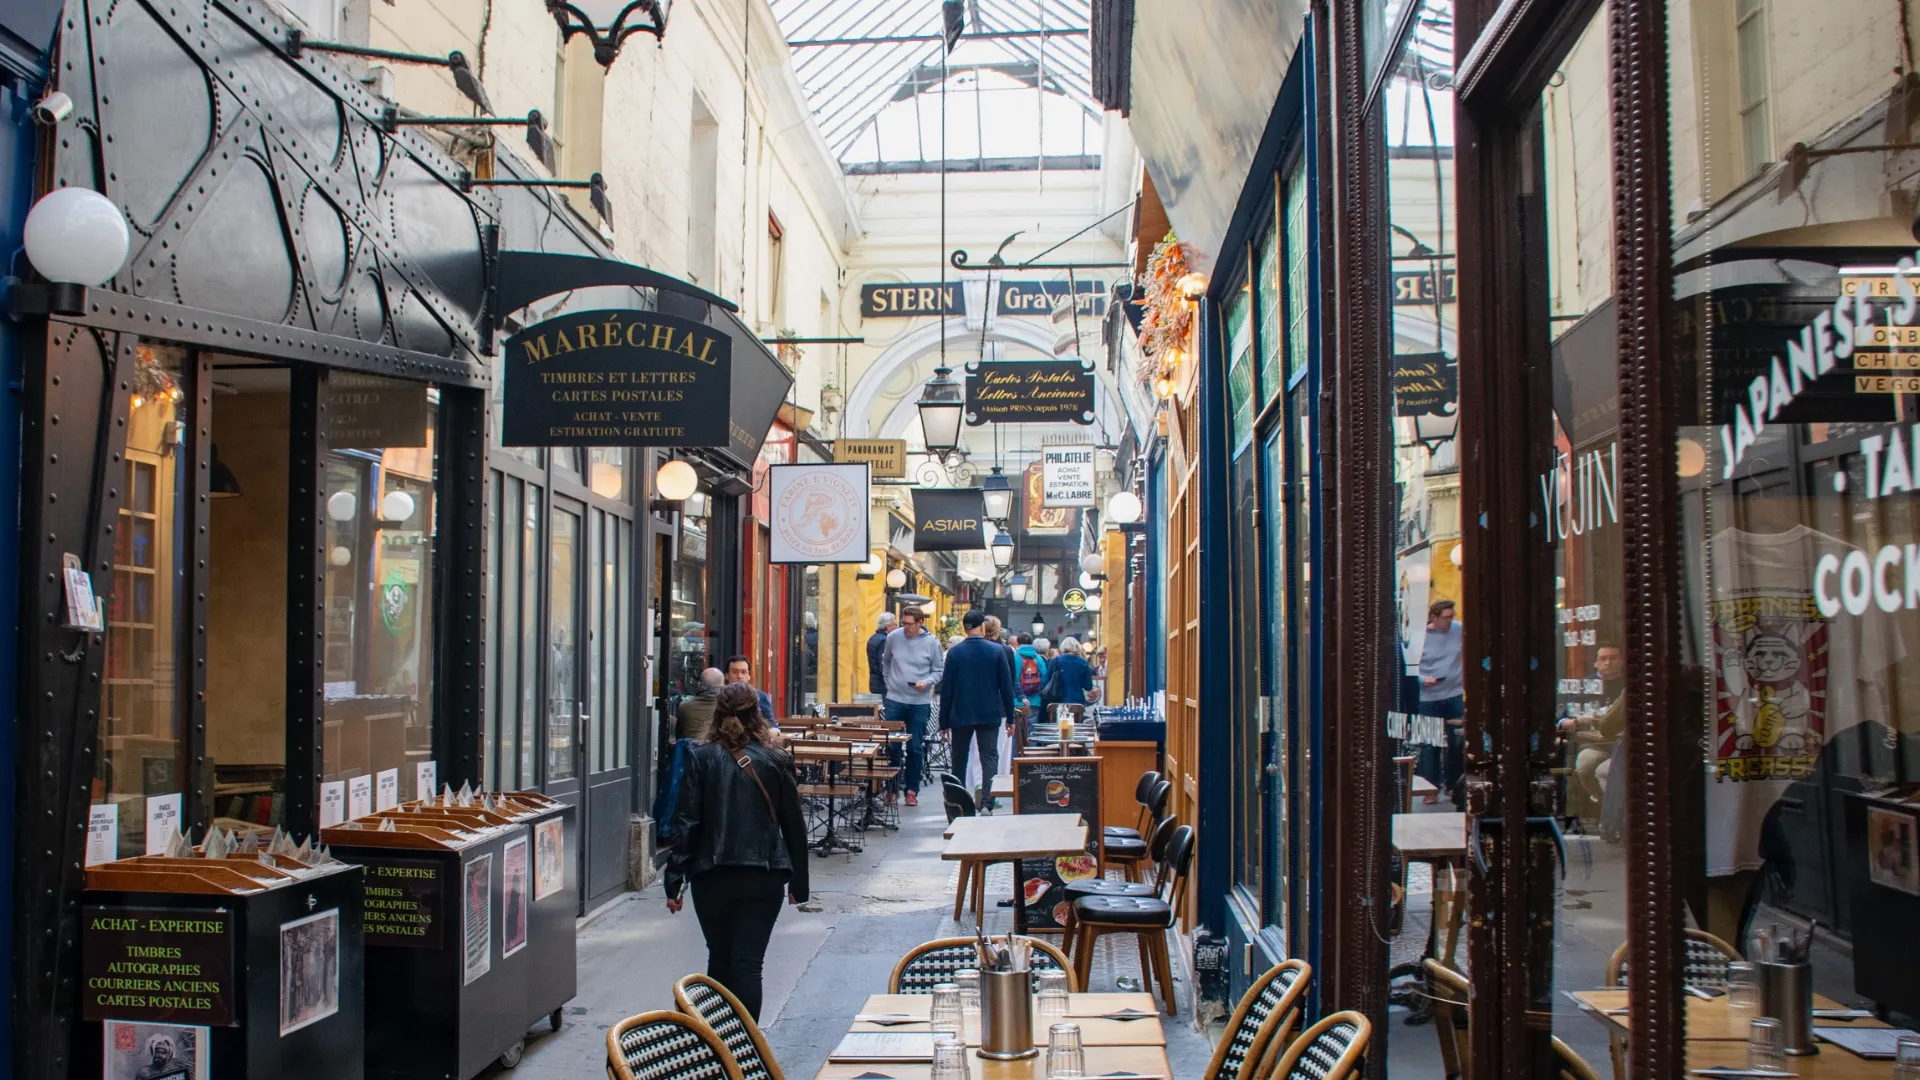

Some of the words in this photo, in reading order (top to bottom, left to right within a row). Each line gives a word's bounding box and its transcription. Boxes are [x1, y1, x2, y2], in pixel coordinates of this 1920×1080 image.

[872, 287, 954, 312] STERN
[521, 313, 718, 366] MARÉCHAL
[541, 372, 604, 384] TIMBRES
[609, 372, 626, 383] ET
[632, 372, 696, 383] LETTRES
[984, 371, 1021, 384] Cartes
[1026, 370, 1076, 384] Postales
[1720, 282, 1874, 480] JAPANESE
[552, 390, 607, 402] CARTES
[612, 390, 683, 402] POSTALES
[977, 386, 1018, 401] Lettres
[1021, 386, 1086, 400] Anciennes
[982, 405, 1008, 413] Maison
[1034, 403, 1057, 413] depuis
[573, 412, 612, 422] ACHAT
[622, 412, 661, 421] VENTE
[550, 427, 620, 437] ESTIMATION
[625, 427, 685, 437] GRATUITE
[848, 445, 895, 455] PANORAMAS
[1045, 452, 1092, 464] PHILATELIE
[1540, 442, 1619, 542] YUJIN
[923, 519, 977, 532] ASTAIR
[378, 867, 436, 879] EXPERTISE
[388, 913, 432, 924] ANCIENS
[91, 918, 138, 931] ACHAT
[149, 919, 224, 934] EXPERTISE
[376, 925, 426, 936] POSTALES
[126, 946, 182, 959] TIMBRES
[107, 962, 201, 976] AUTOGRAPHES
[89, 977, 161, 991] COURRIERS
[163, 981, 220, 993] ANCIENS
[97, 994, 146, 1007] CARTES
[149, 995, 212, 1009] POSTALES
